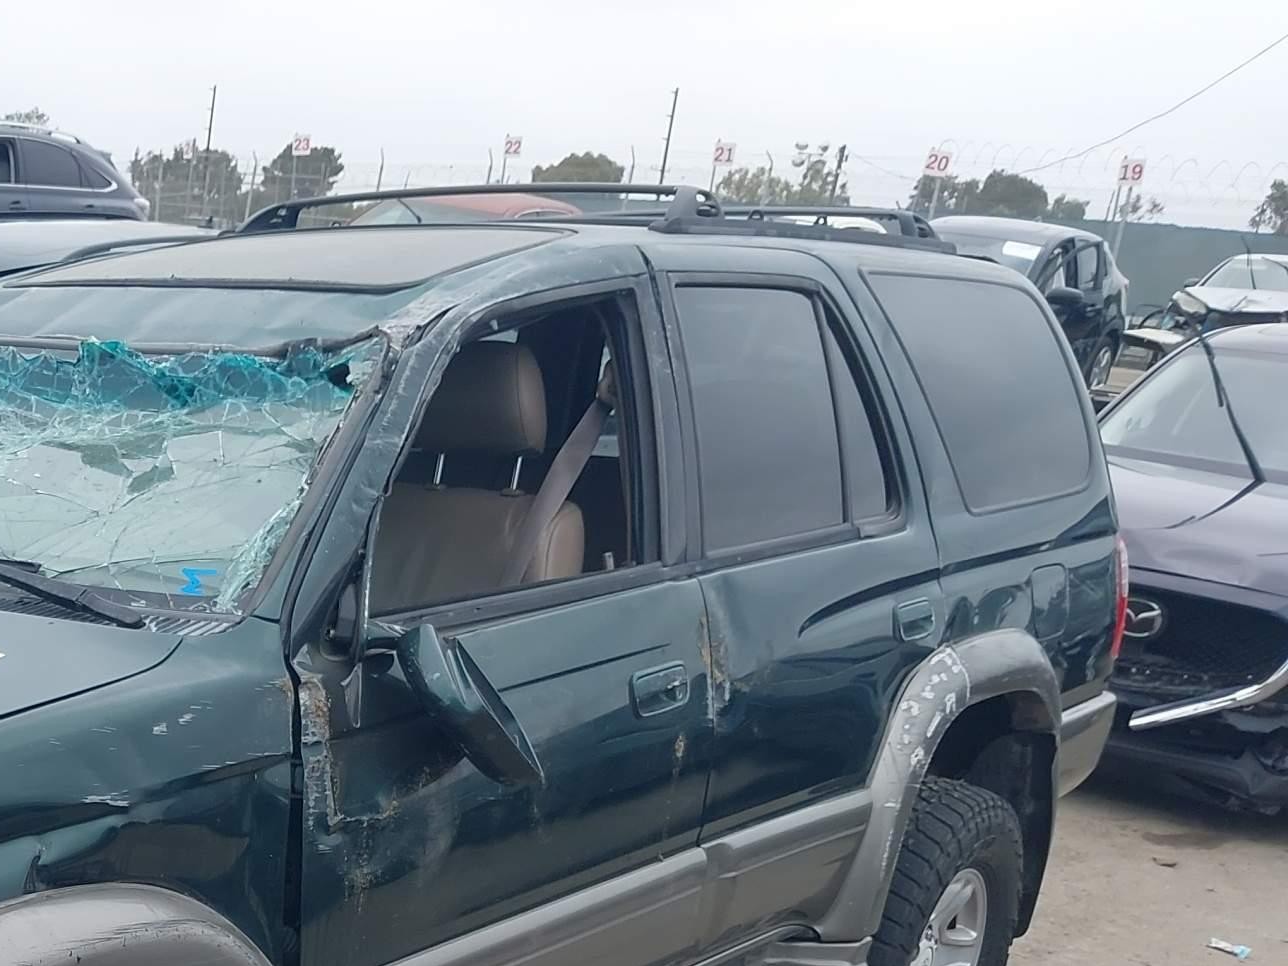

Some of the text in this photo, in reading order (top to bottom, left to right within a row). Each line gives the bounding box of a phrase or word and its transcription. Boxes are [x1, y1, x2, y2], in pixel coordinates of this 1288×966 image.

[295, 137, 310, 152] 23
[505, 140, 521, 155] 22
[714, 147, 733, 163] 21
[925, 154, 949, 171] 20
[1119, 164, 1143, 181] 19
